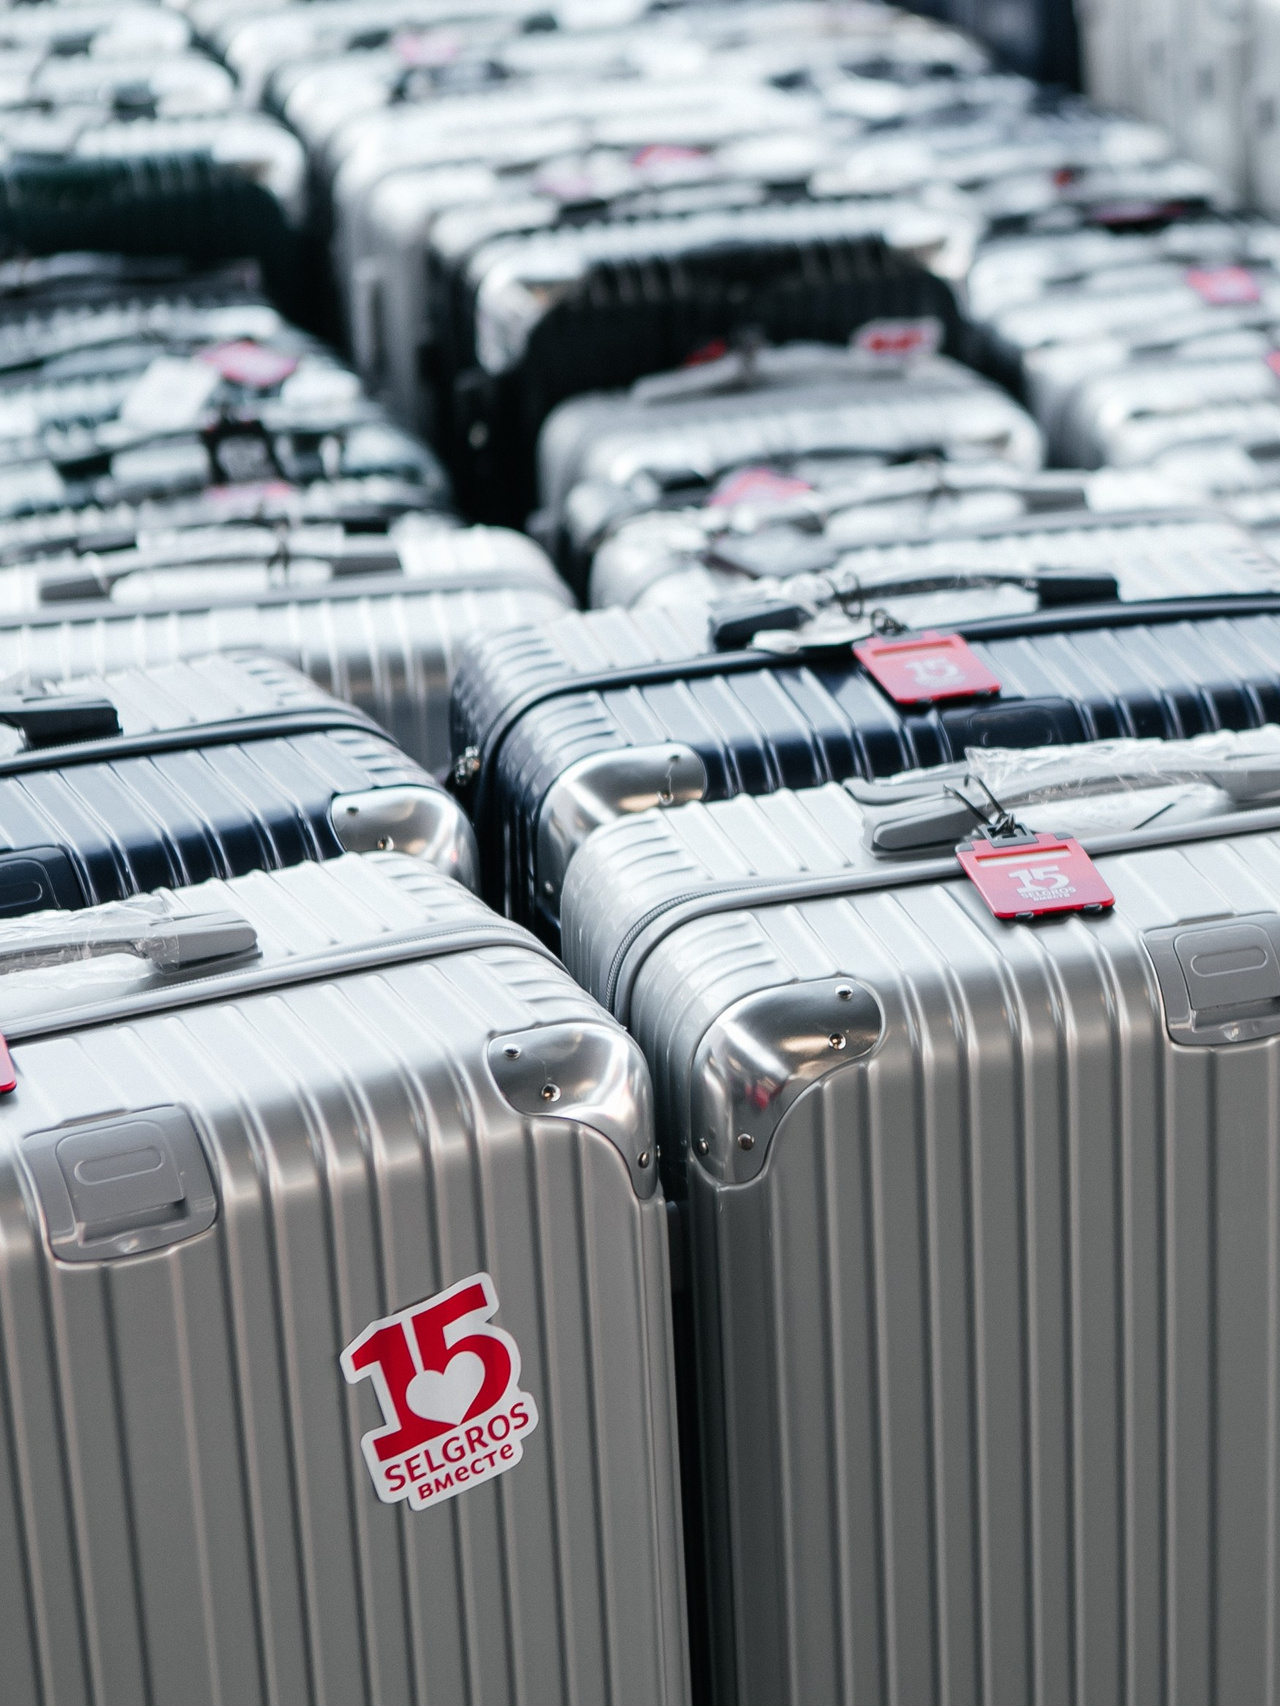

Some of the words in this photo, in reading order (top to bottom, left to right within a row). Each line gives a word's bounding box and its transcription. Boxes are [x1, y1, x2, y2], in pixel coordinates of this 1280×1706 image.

[1008, 864, 1070, 893] 15
[351, 1282, 512, 1462] 15
[384, 1402, 529, 1492] SELGROS
